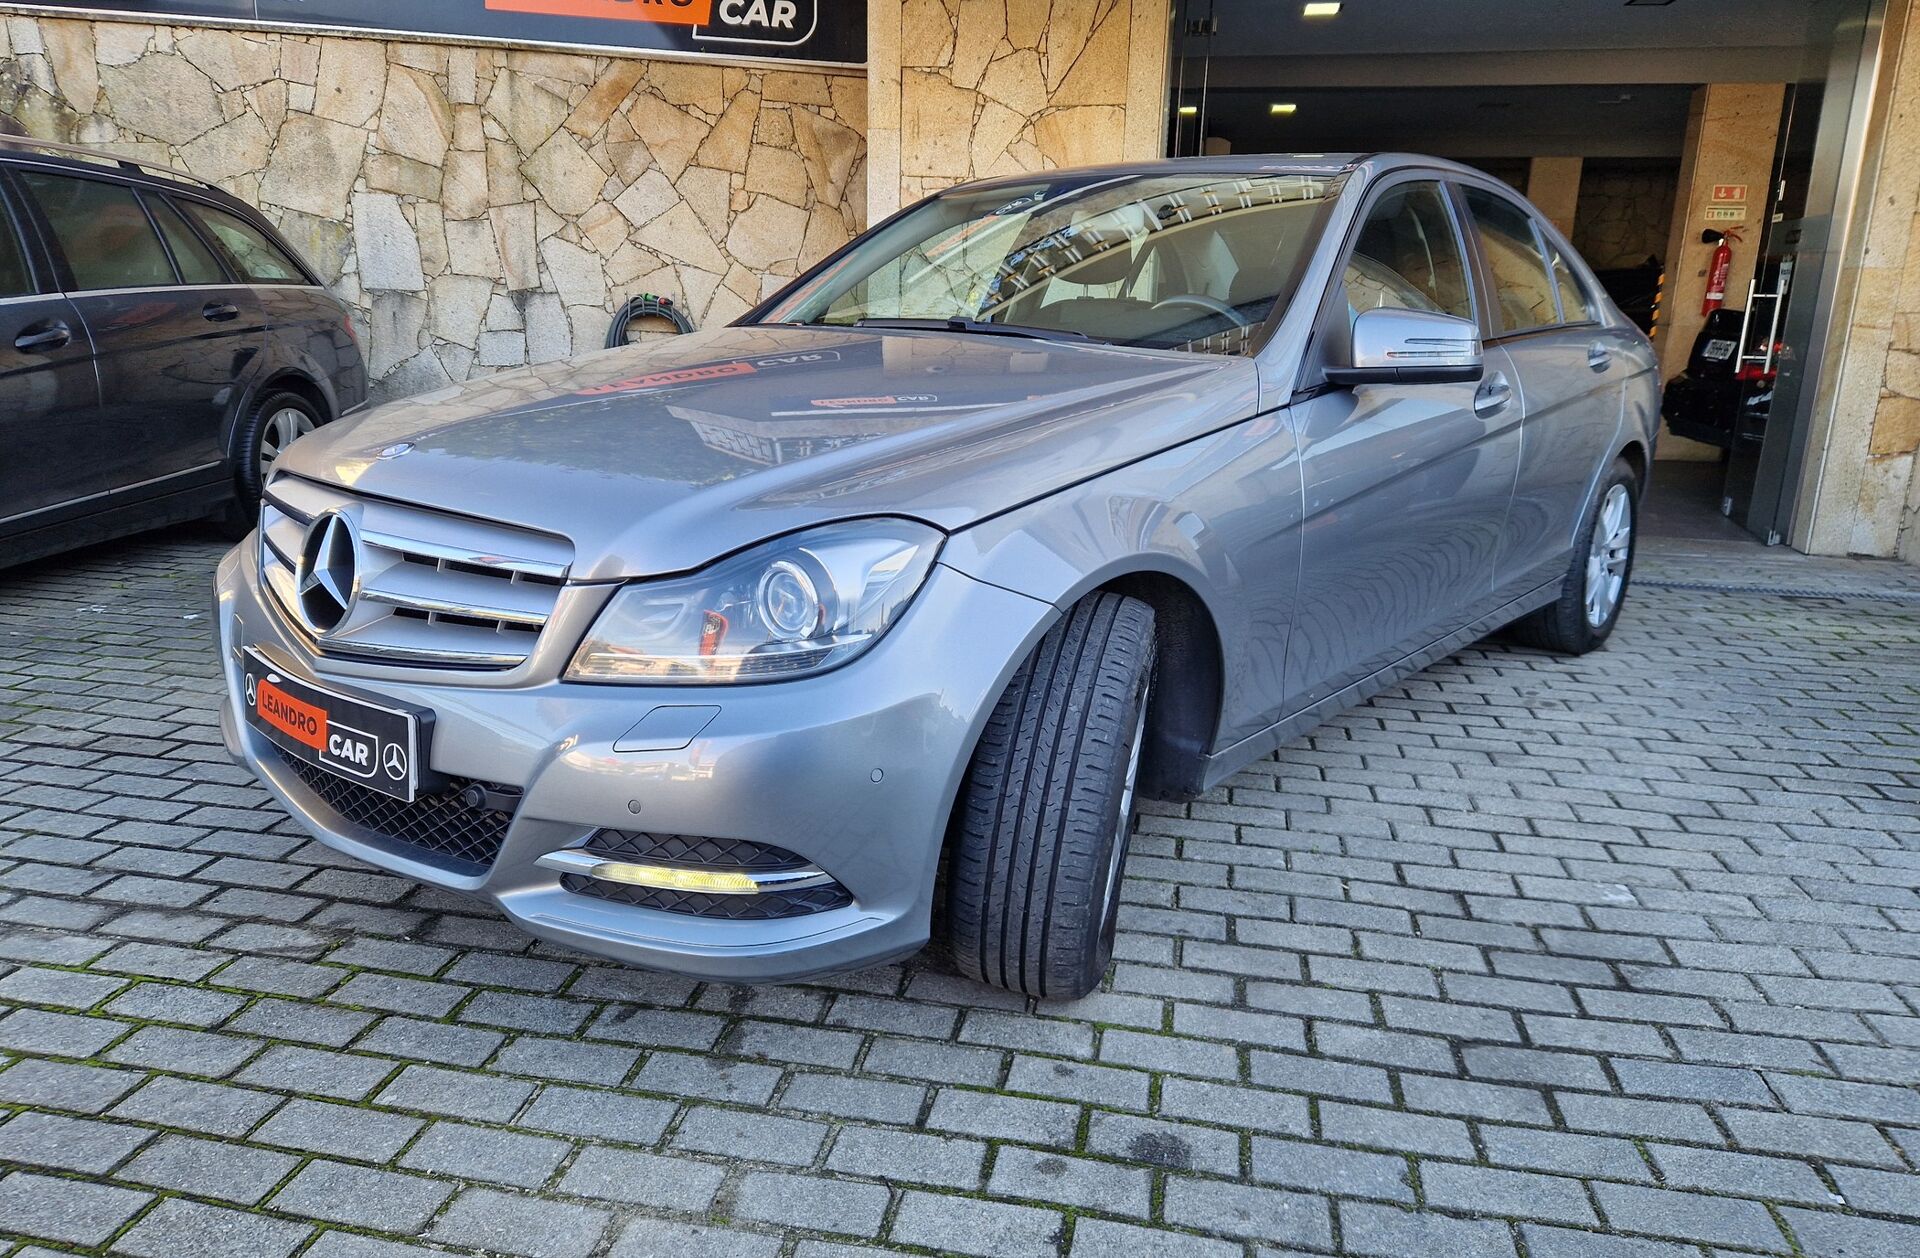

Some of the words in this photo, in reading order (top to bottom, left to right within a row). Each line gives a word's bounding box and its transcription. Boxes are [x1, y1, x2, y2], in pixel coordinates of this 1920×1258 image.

[719, 0, 797, 29] CAR
[262, 690, 317, 735] LEANDRO
[329, 734, 369, 767] CAR
